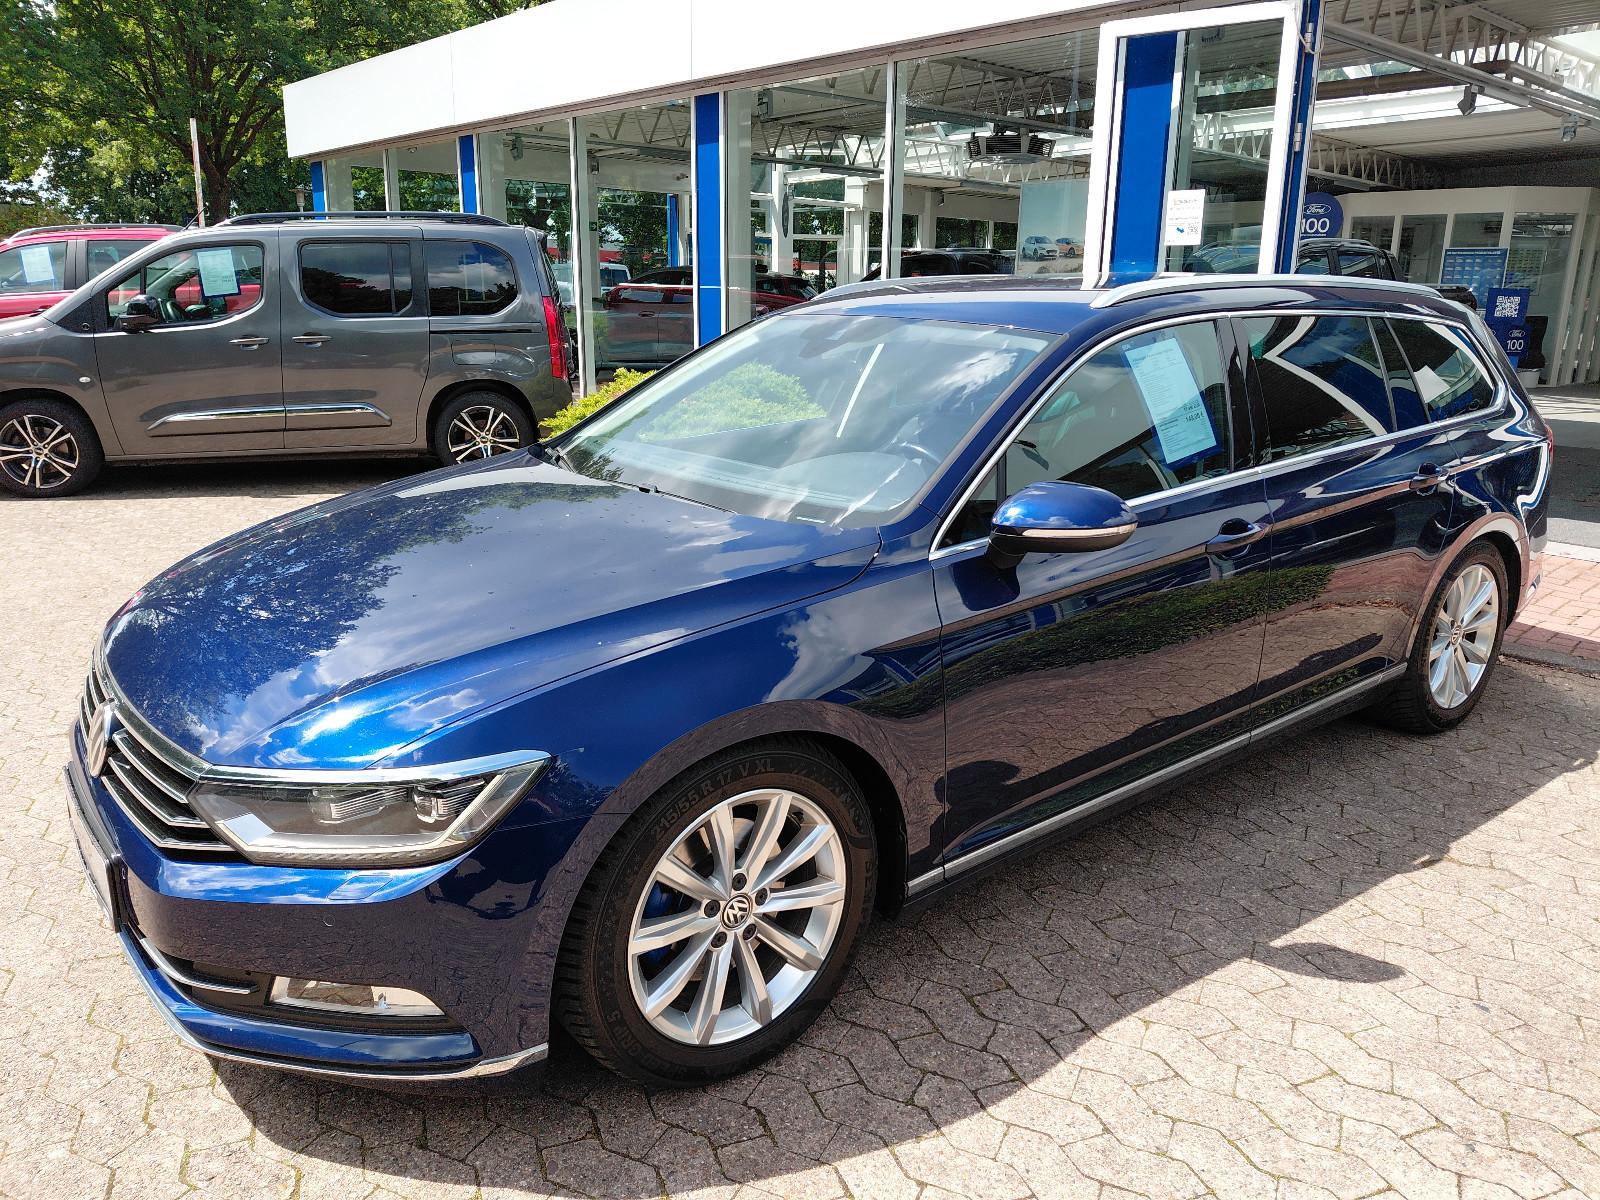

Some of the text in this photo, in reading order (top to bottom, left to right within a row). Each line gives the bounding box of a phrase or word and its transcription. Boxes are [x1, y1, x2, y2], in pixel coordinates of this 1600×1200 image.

[1306, 205, 1326, 214] Ford
[1506, 340, 1524, 350] 100
[651, 758, 776, 839] 215/55 R 17 V XL
[724, 895, 751, 928] VW
